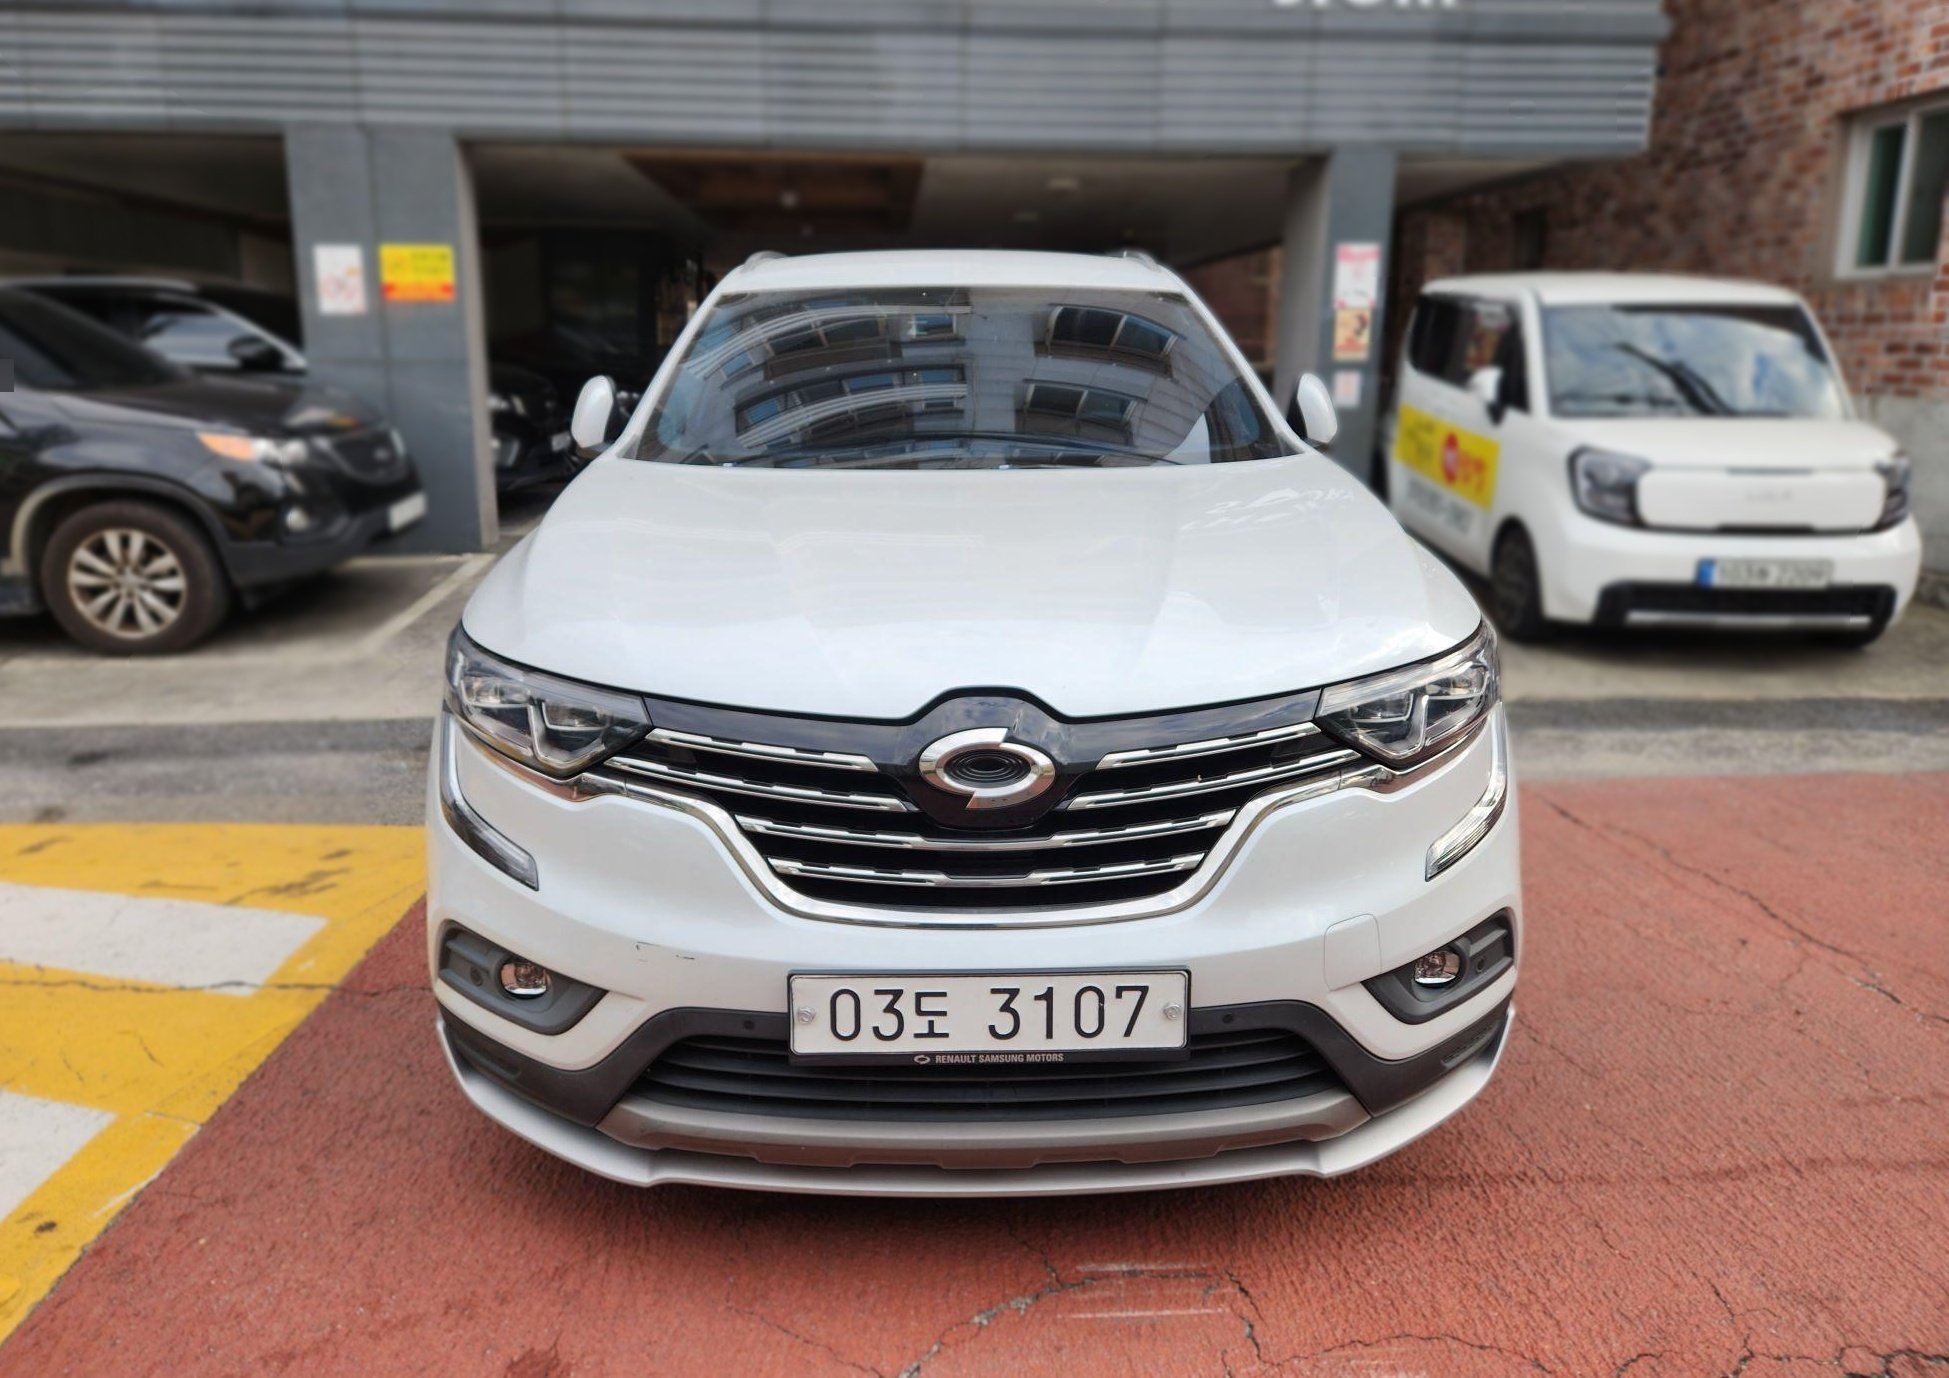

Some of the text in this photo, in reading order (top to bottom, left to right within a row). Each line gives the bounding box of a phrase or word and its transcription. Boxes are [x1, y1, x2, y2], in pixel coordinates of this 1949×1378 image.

[829, 985, 1150, 1042] 03도 3107
[935, 1053, 1064, 1064] RENAULT SAMSUNG MOTORS
